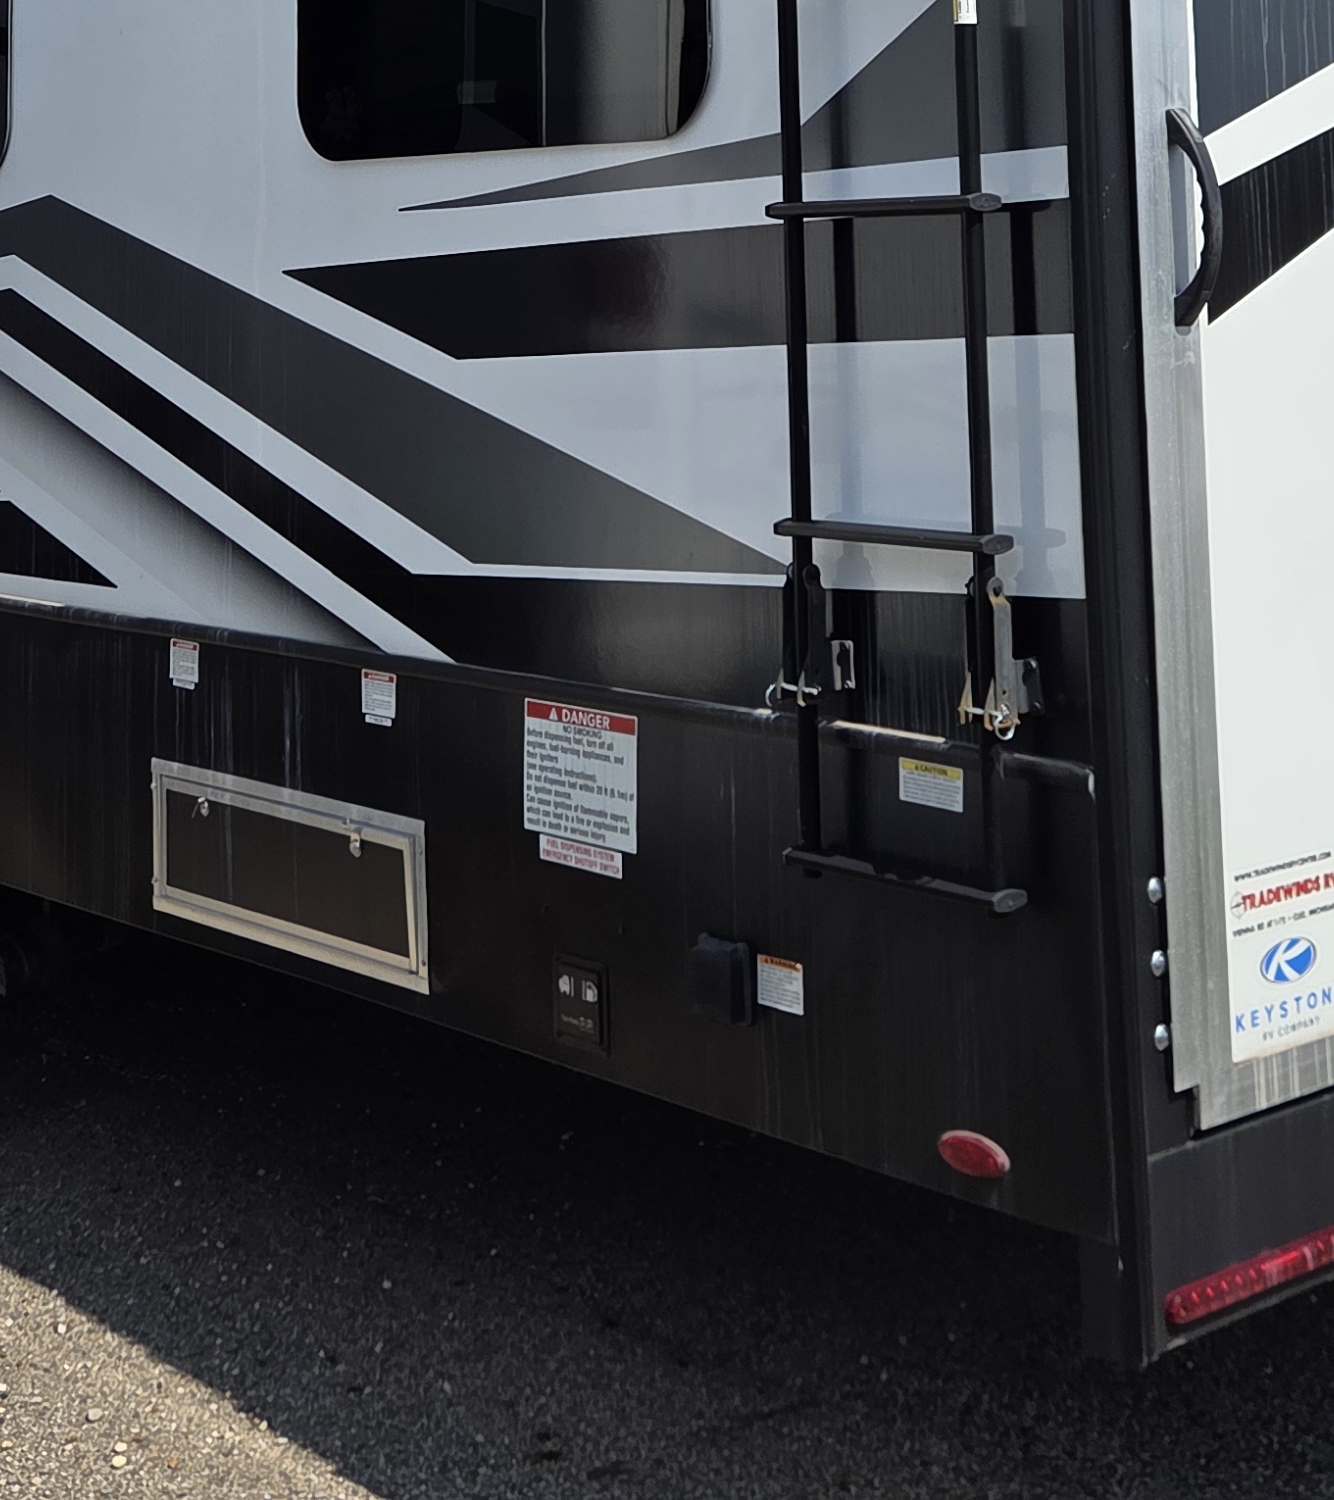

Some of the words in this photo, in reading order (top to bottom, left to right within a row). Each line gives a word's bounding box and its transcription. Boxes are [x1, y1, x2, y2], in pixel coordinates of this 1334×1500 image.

[561, 708, 610, 730] DANGER
[562, 725, 572, 734] NO
[573, 726, 602, 740] SMOKING
[1241, 875, 1320, 912] TRADEWINDS
